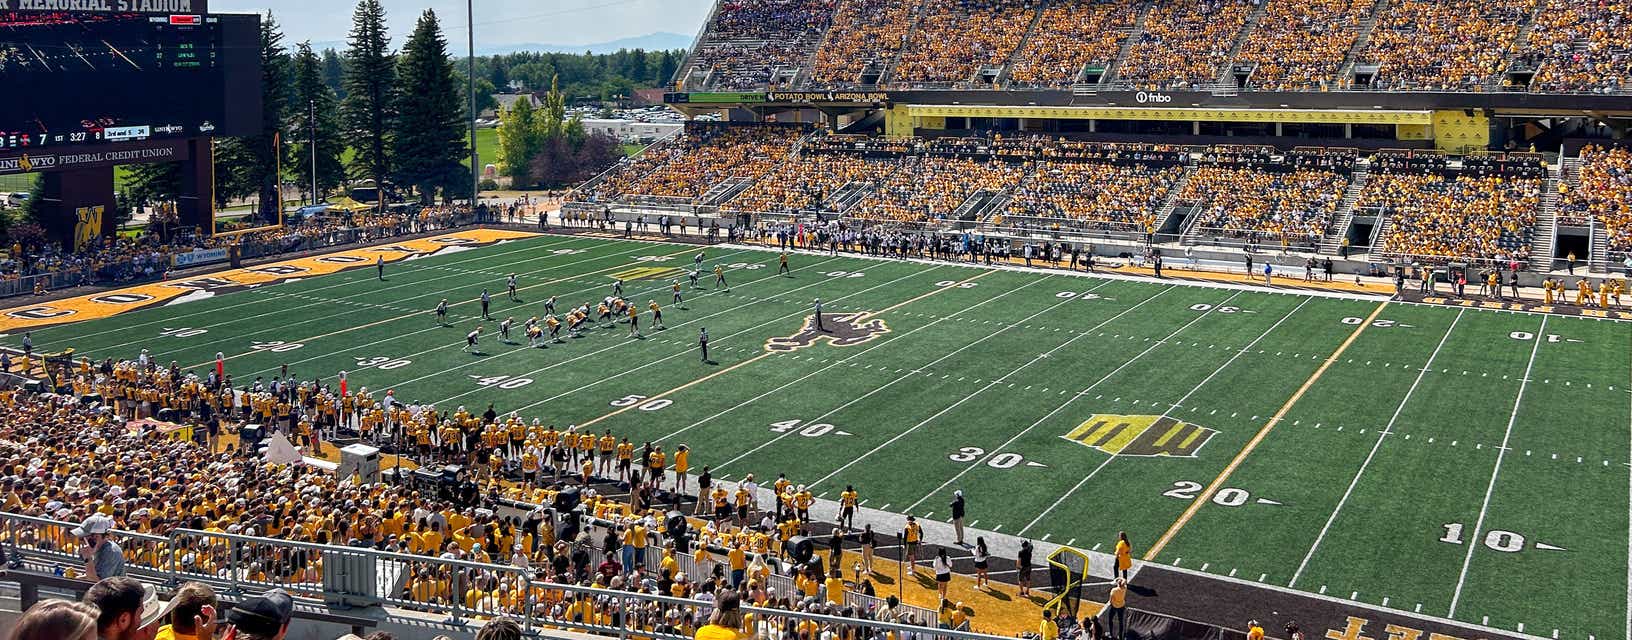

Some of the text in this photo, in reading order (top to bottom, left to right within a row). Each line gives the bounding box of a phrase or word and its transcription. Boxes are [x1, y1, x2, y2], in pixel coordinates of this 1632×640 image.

[20, 0, 111, 11] MEMORIAL
[118, 0, 192, 12] STADIUM
[1149, 93, 1171, 102] fnbo
[39, 134, 47, 145] 7
[70, 132, 86, 142] 3:27
[31, 156, 55, 167] WYO
[59, 147, 173, 165] FEDERAL CREDIT UNION
[356, 356, 412, 370] 30
[477, 374, 535, 389] 40
[610, 394, 674, 412] 50
[769, 418, 836, 438] 40
[948, 446, 1024, 470] 30
[1161, 480, 1251, 507] 20
[1439, 523, 1526, 553] 10
